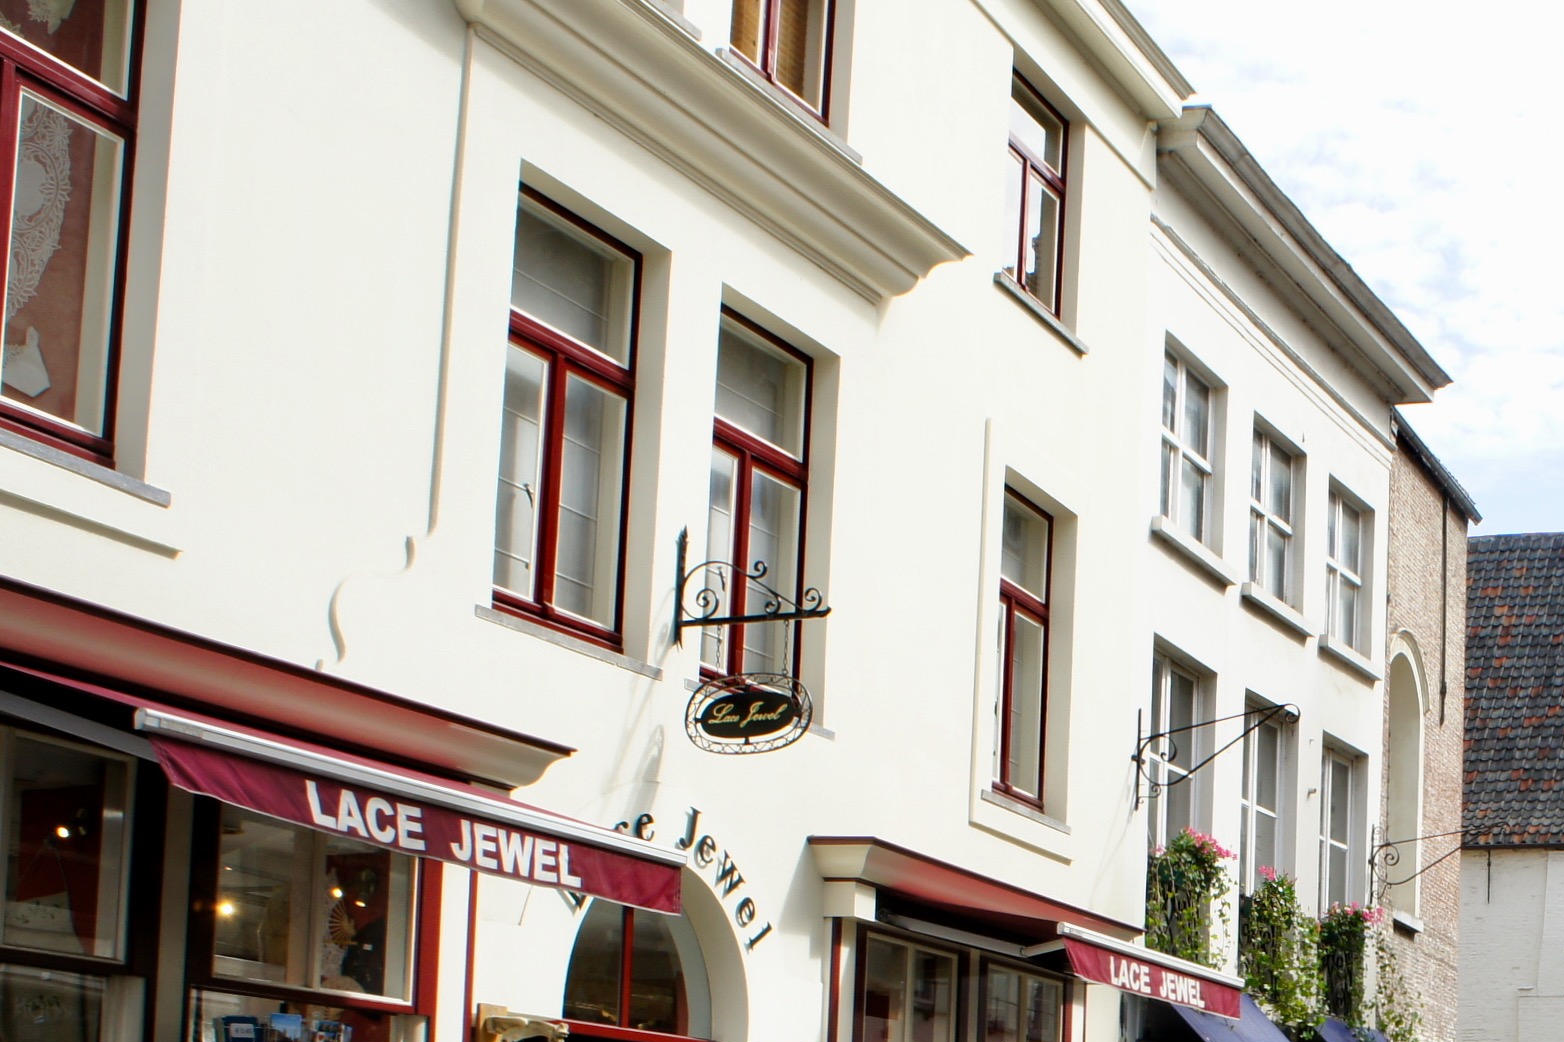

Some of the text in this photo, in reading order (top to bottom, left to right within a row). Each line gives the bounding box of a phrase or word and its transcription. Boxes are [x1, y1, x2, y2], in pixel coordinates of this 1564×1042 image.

[708, 701, 788, 728] Lace Jewel
[305, 779, 426, 851] LACE
[450, 819, 582, 889] JEWEL
[1109, 955, 1206, 1009] LACE JEWEL
